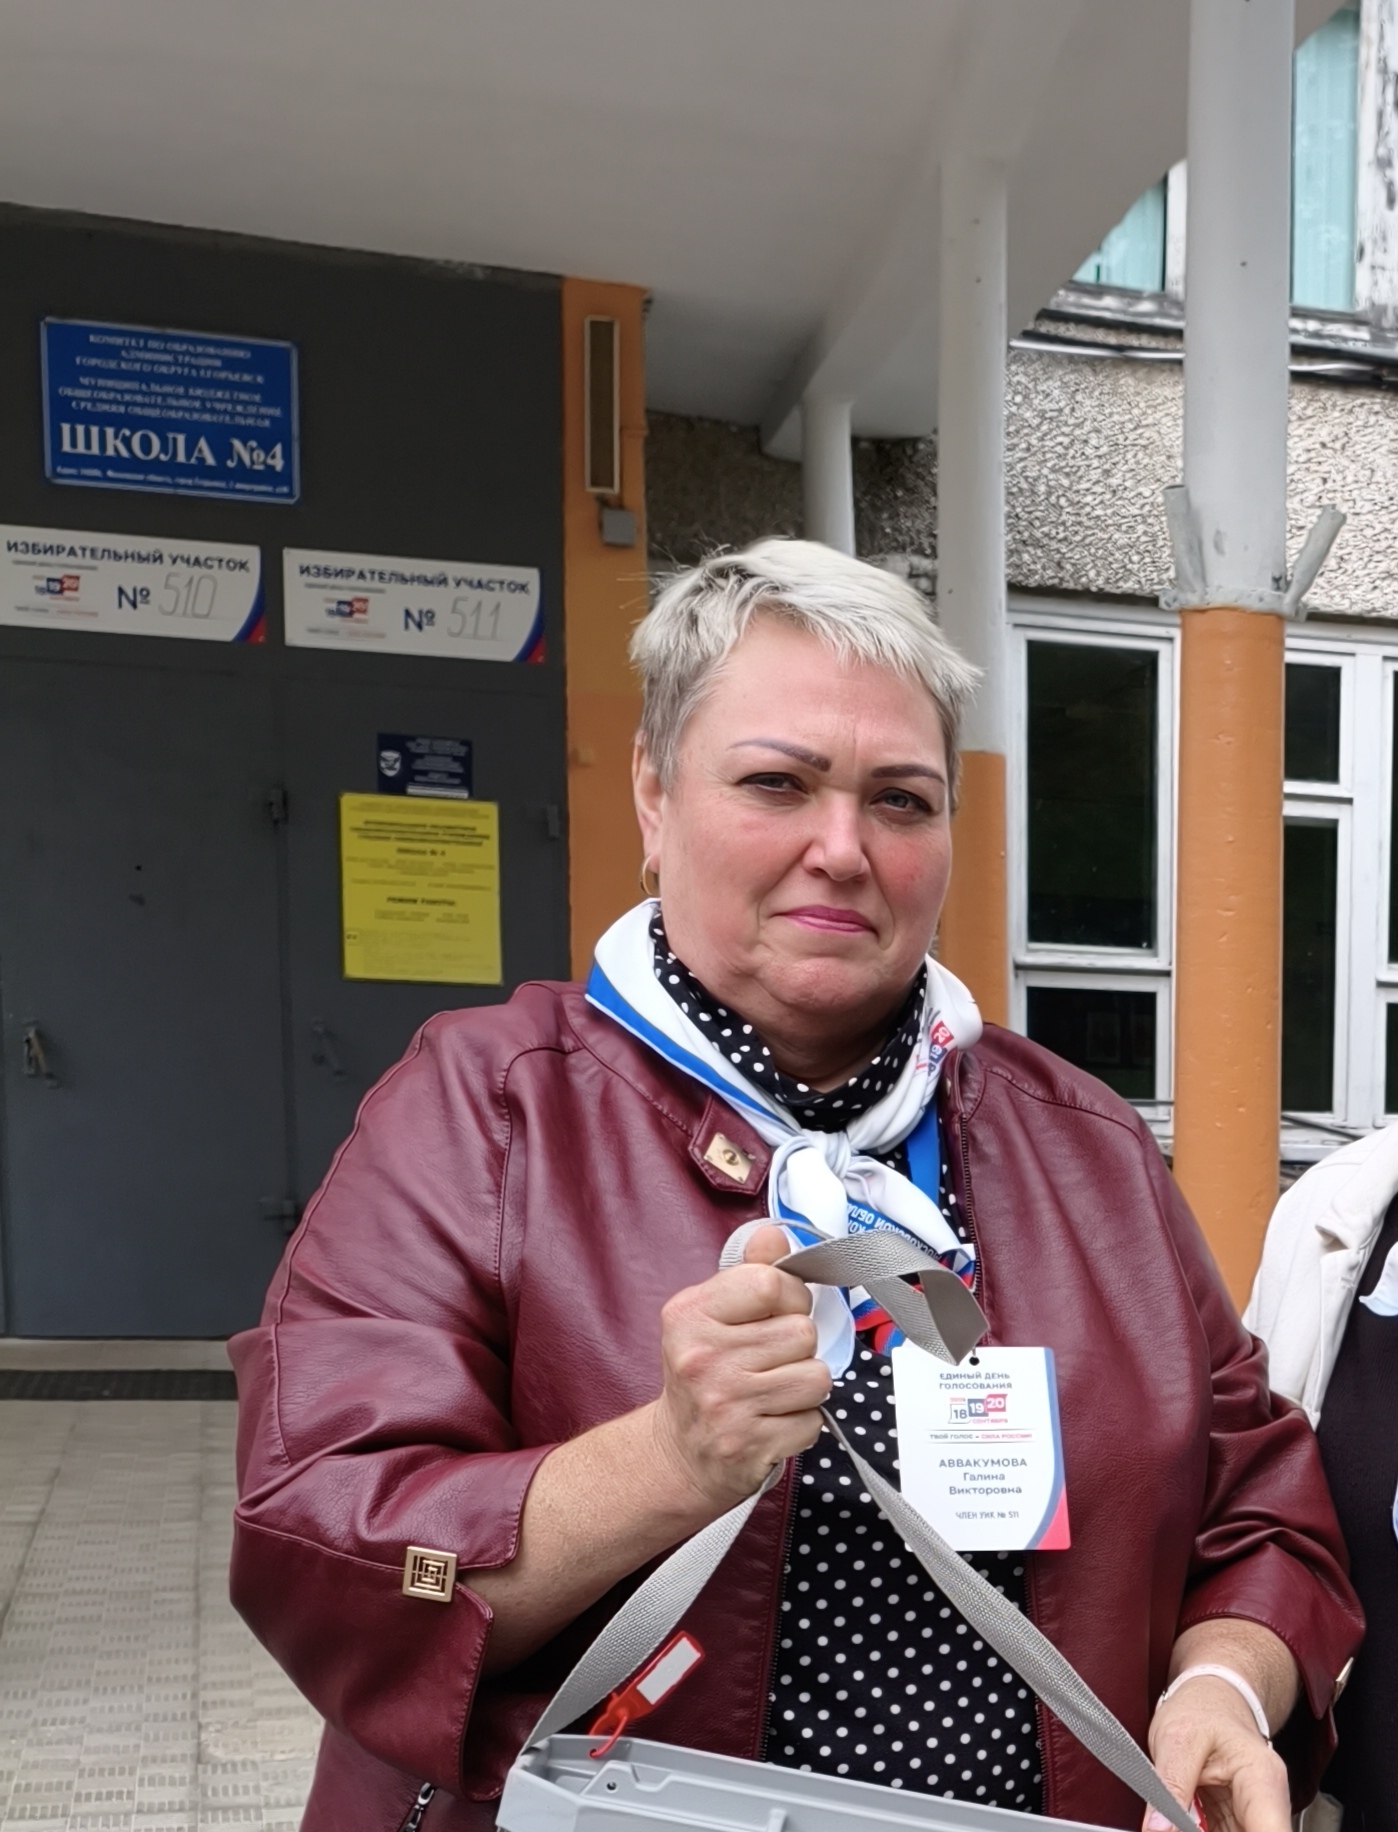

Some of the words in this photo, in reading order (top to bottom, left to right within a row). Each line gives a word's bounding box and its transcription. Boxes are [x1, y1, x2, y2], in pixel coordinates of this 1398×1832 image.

[60, 423, 217, 466] ШКОЛА
[226, 437, 284, 472] №4
[6, 540, 164, 565] ИЗБИРАТЕЛЬНЫЙ
[170, 554, 250, 573] УЧАСТОК
[299, 565, 448, 588] ИЗБИРАТЕЛЬНЫЙ
[453, 578, 530, 596] УЧАСТОК
[117, 585, 151, 610] №
[158, 572, 218, 619] 510
[403, 608, 436, 632] №
[447, 596, 503, 641] 511
[939, 1371, 982, 1380] ЕДИНЫЙ
[984, 1372, 1010, 1380] ДЕНЬ
[939, 1382, 1012, 1390] ГОЛОСОВАНИЯ
[953, 1409, 968, 1419] 18
[969, 1402, 984, 1414] 19
[986, 1397, 1005, 1409] 20
[938, 1458, 1028, 1468] АВВАКУМОВА
[963, 1472, 1006, 1481] Галина
[949, 1486, 1022, 1496] Викторовна
[956, 1511, 978, 1519] ЧЛЕН
[979, 1511, 996, 1519] УИК
[997, 1511, 1006, 1519] №
